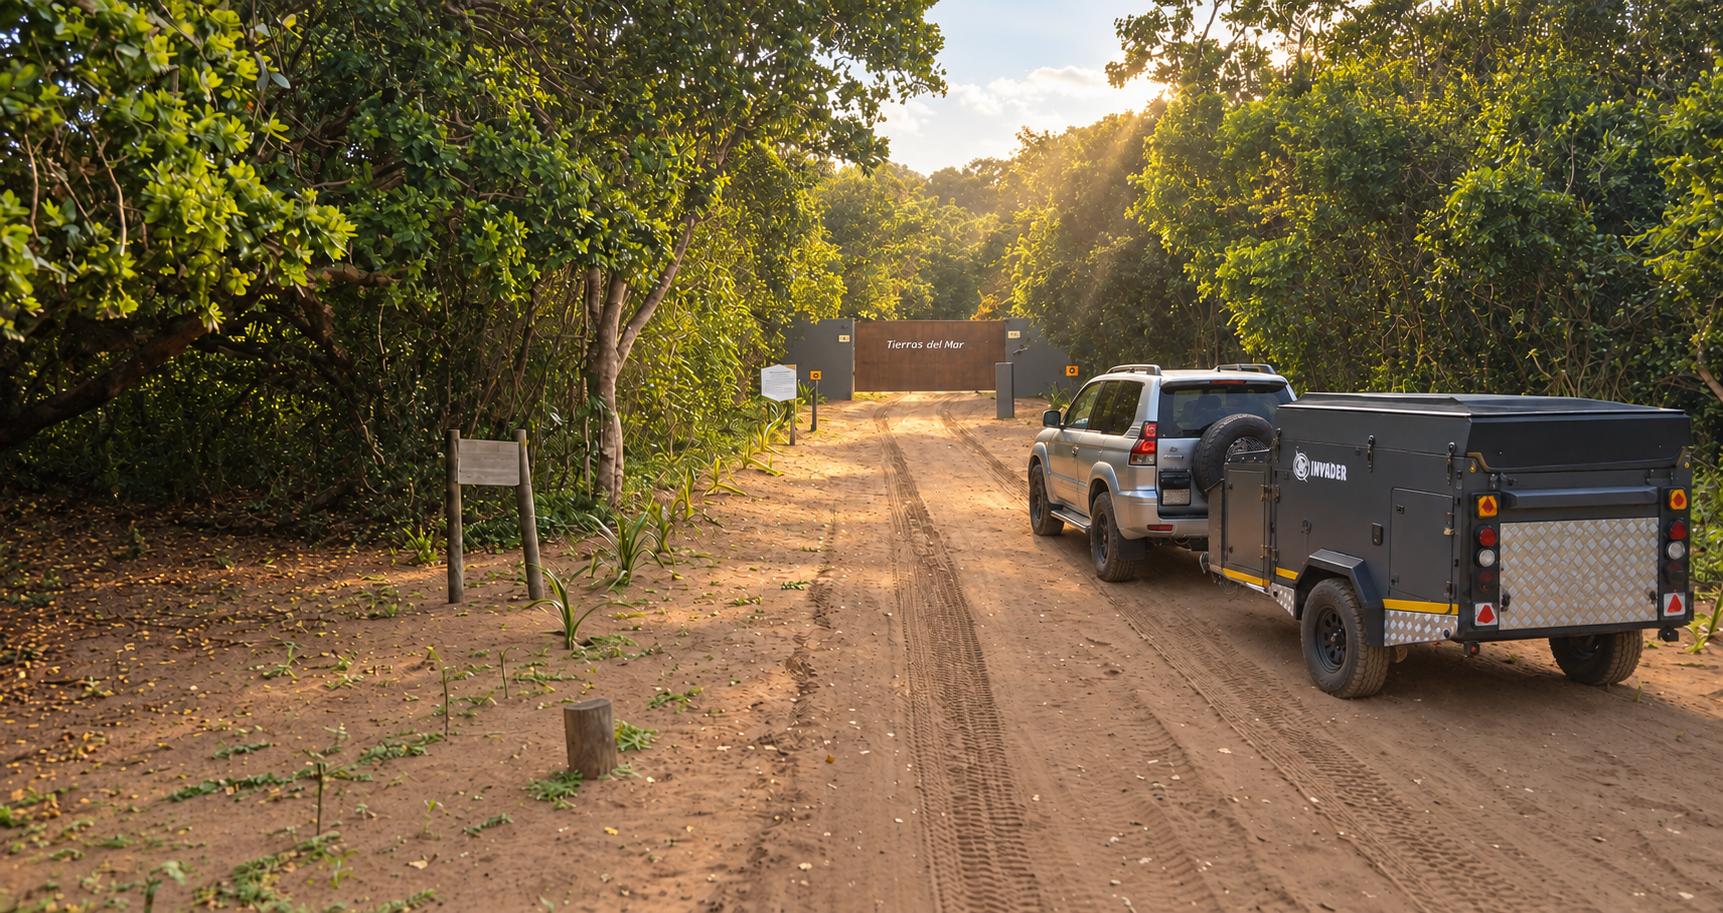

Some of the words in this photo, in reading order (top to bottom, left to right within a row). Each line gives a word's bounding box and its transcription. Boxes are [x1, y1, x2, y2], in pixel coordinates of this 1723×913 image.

[887, 340, 923, 349] Tierras
[926, 340, 943, 349] del
[944, 340, 965, 349] Mar
[1310, 460, 1347, 481] INVADER
